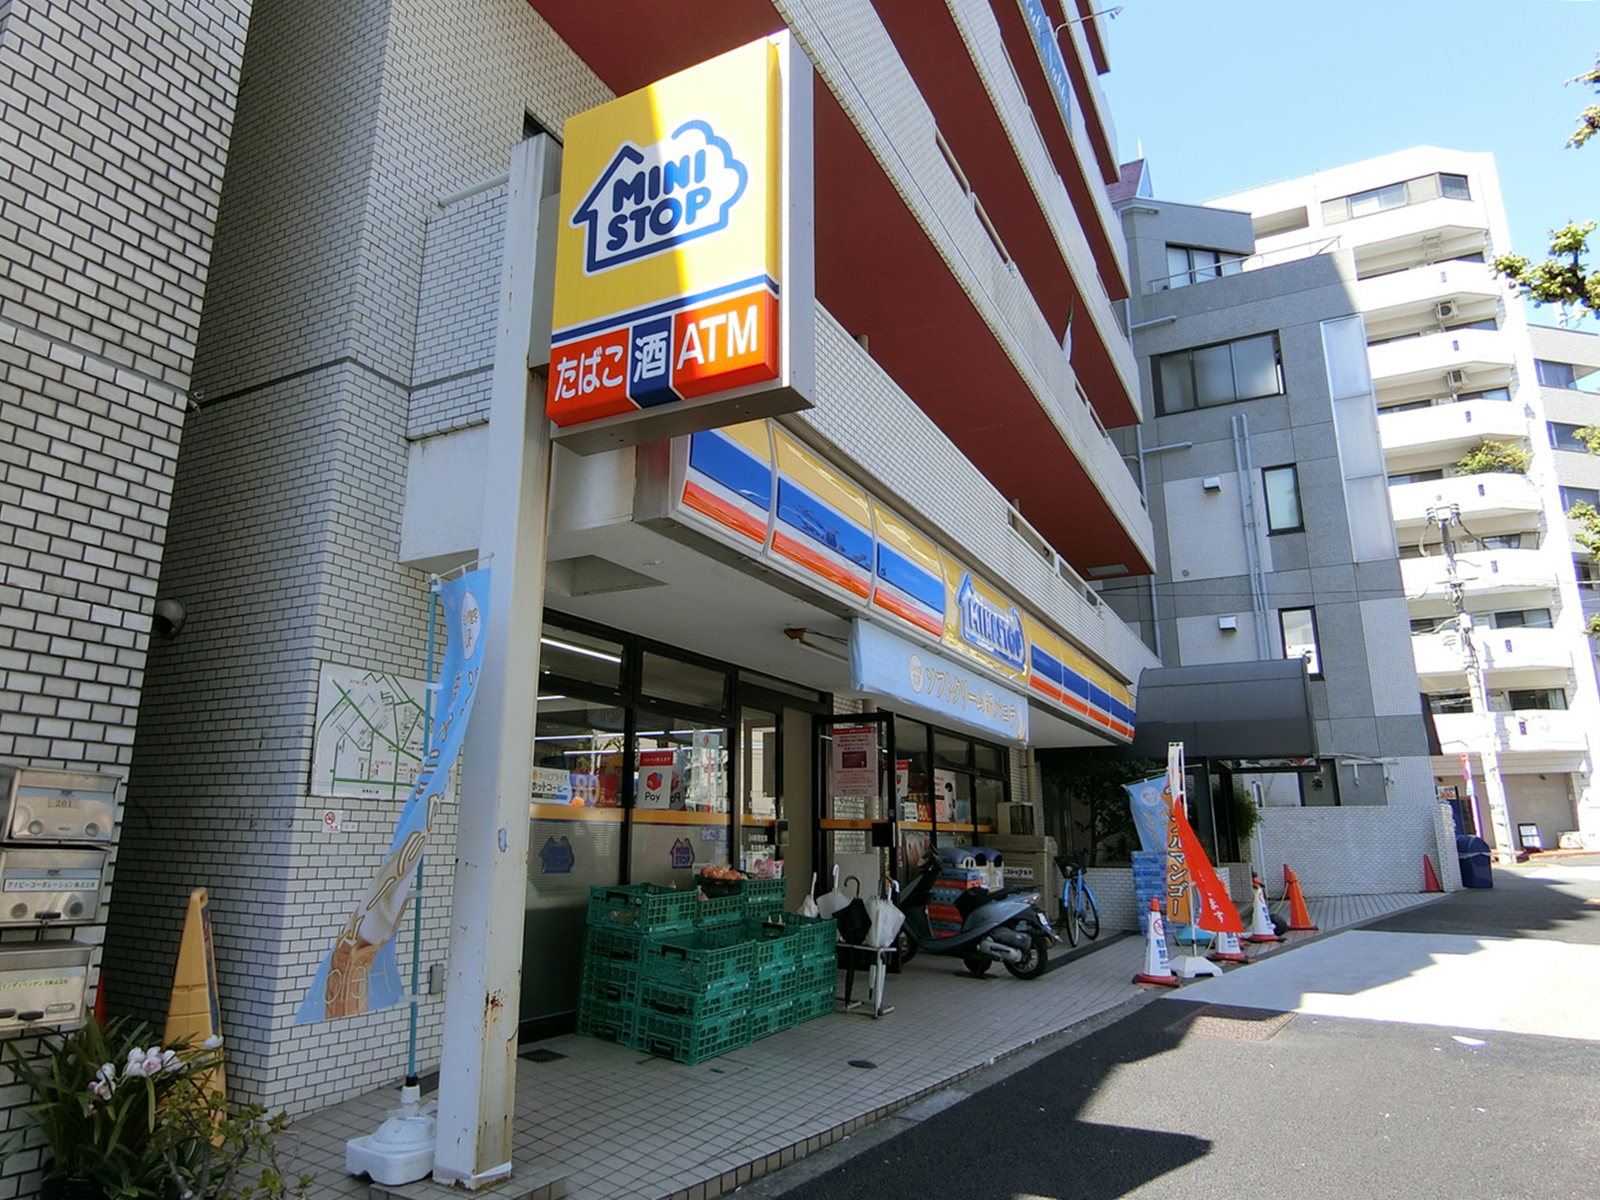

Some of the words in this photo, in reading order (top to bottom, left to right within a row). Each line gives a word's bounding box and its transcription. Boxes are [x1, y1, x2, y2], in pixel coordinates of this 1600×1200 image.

[612, 148, 706, 214] MINI
[605, 186, 712, 252] STOP
[554, 344, 625, 402] たばこ
[633, 330, 668, 384] 酒
[676, 304, 759, 371] ATM
[644, 791, 661, 803] Pay
